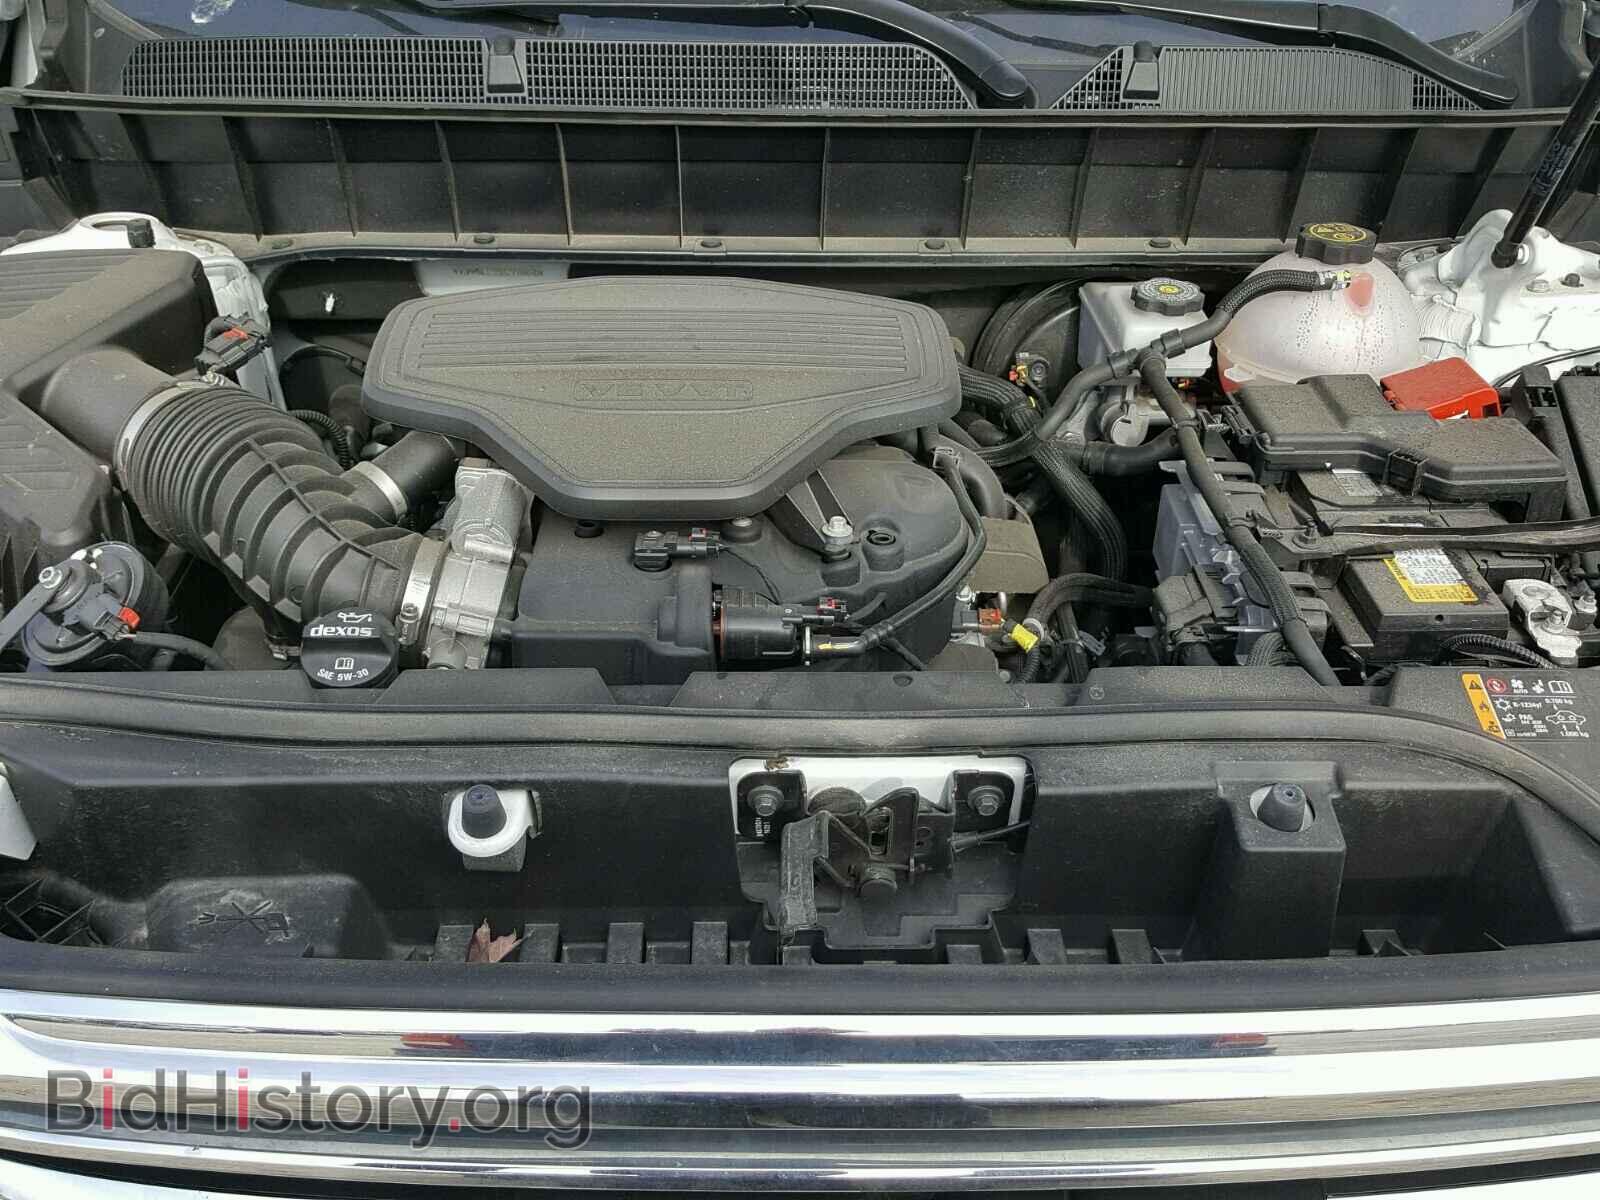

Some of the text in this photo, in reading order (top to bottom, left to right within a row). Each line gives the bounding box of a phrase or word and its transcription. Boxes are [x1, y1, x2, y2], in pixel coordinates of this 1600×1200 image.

[309, 624, 376, 637] dexos
[317, 668, 369, 681] SAE 5W-30
